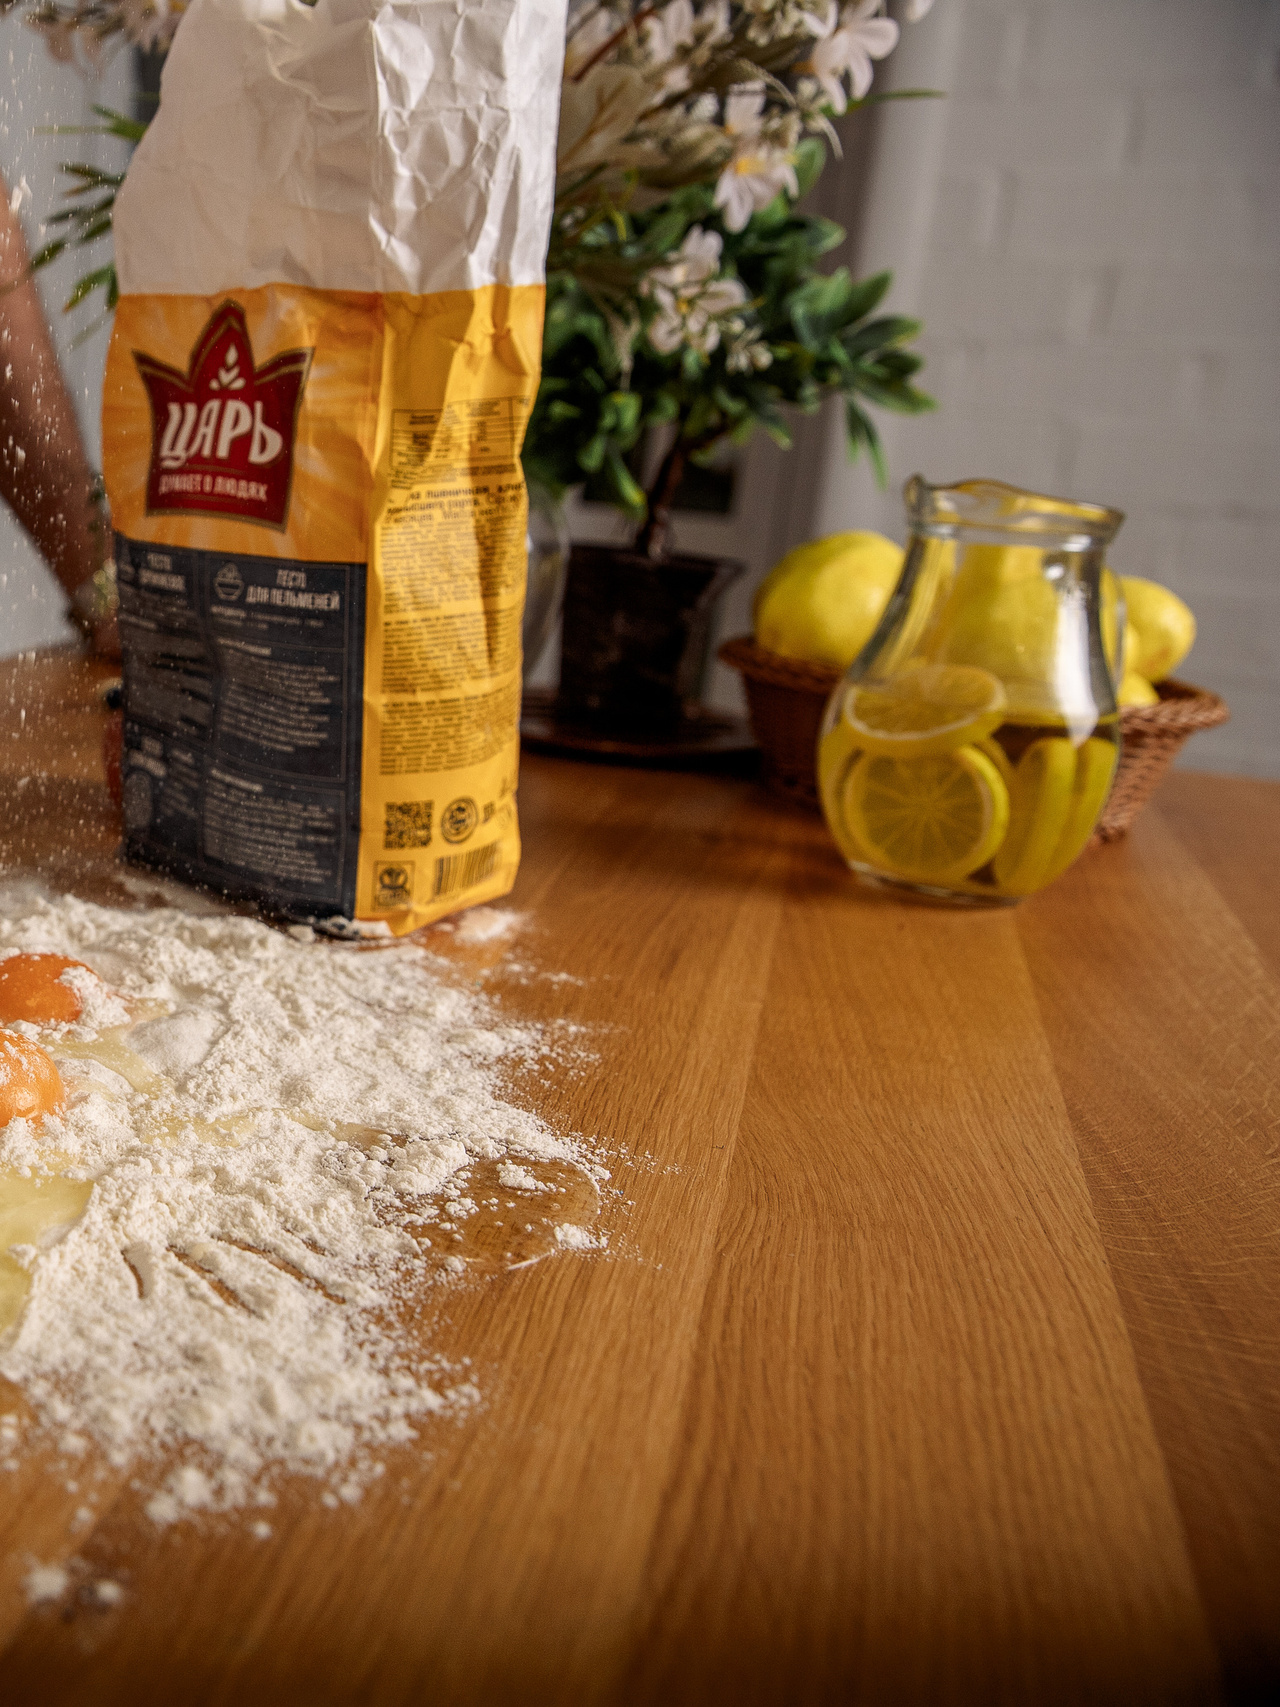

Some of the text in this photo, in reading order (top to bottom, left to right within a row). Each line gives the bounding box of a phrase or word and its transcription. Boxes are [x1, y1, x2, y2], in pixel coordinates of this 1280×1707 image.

[158, 398, 283, 469] ЦАРЬ
[203, 473, 213, 493] О
[213, 475, 268, 502] ЛЮДЯХ
[245, 585, 340, 611] ДЛЯ ПЕЛЬМЕНЕЙ
